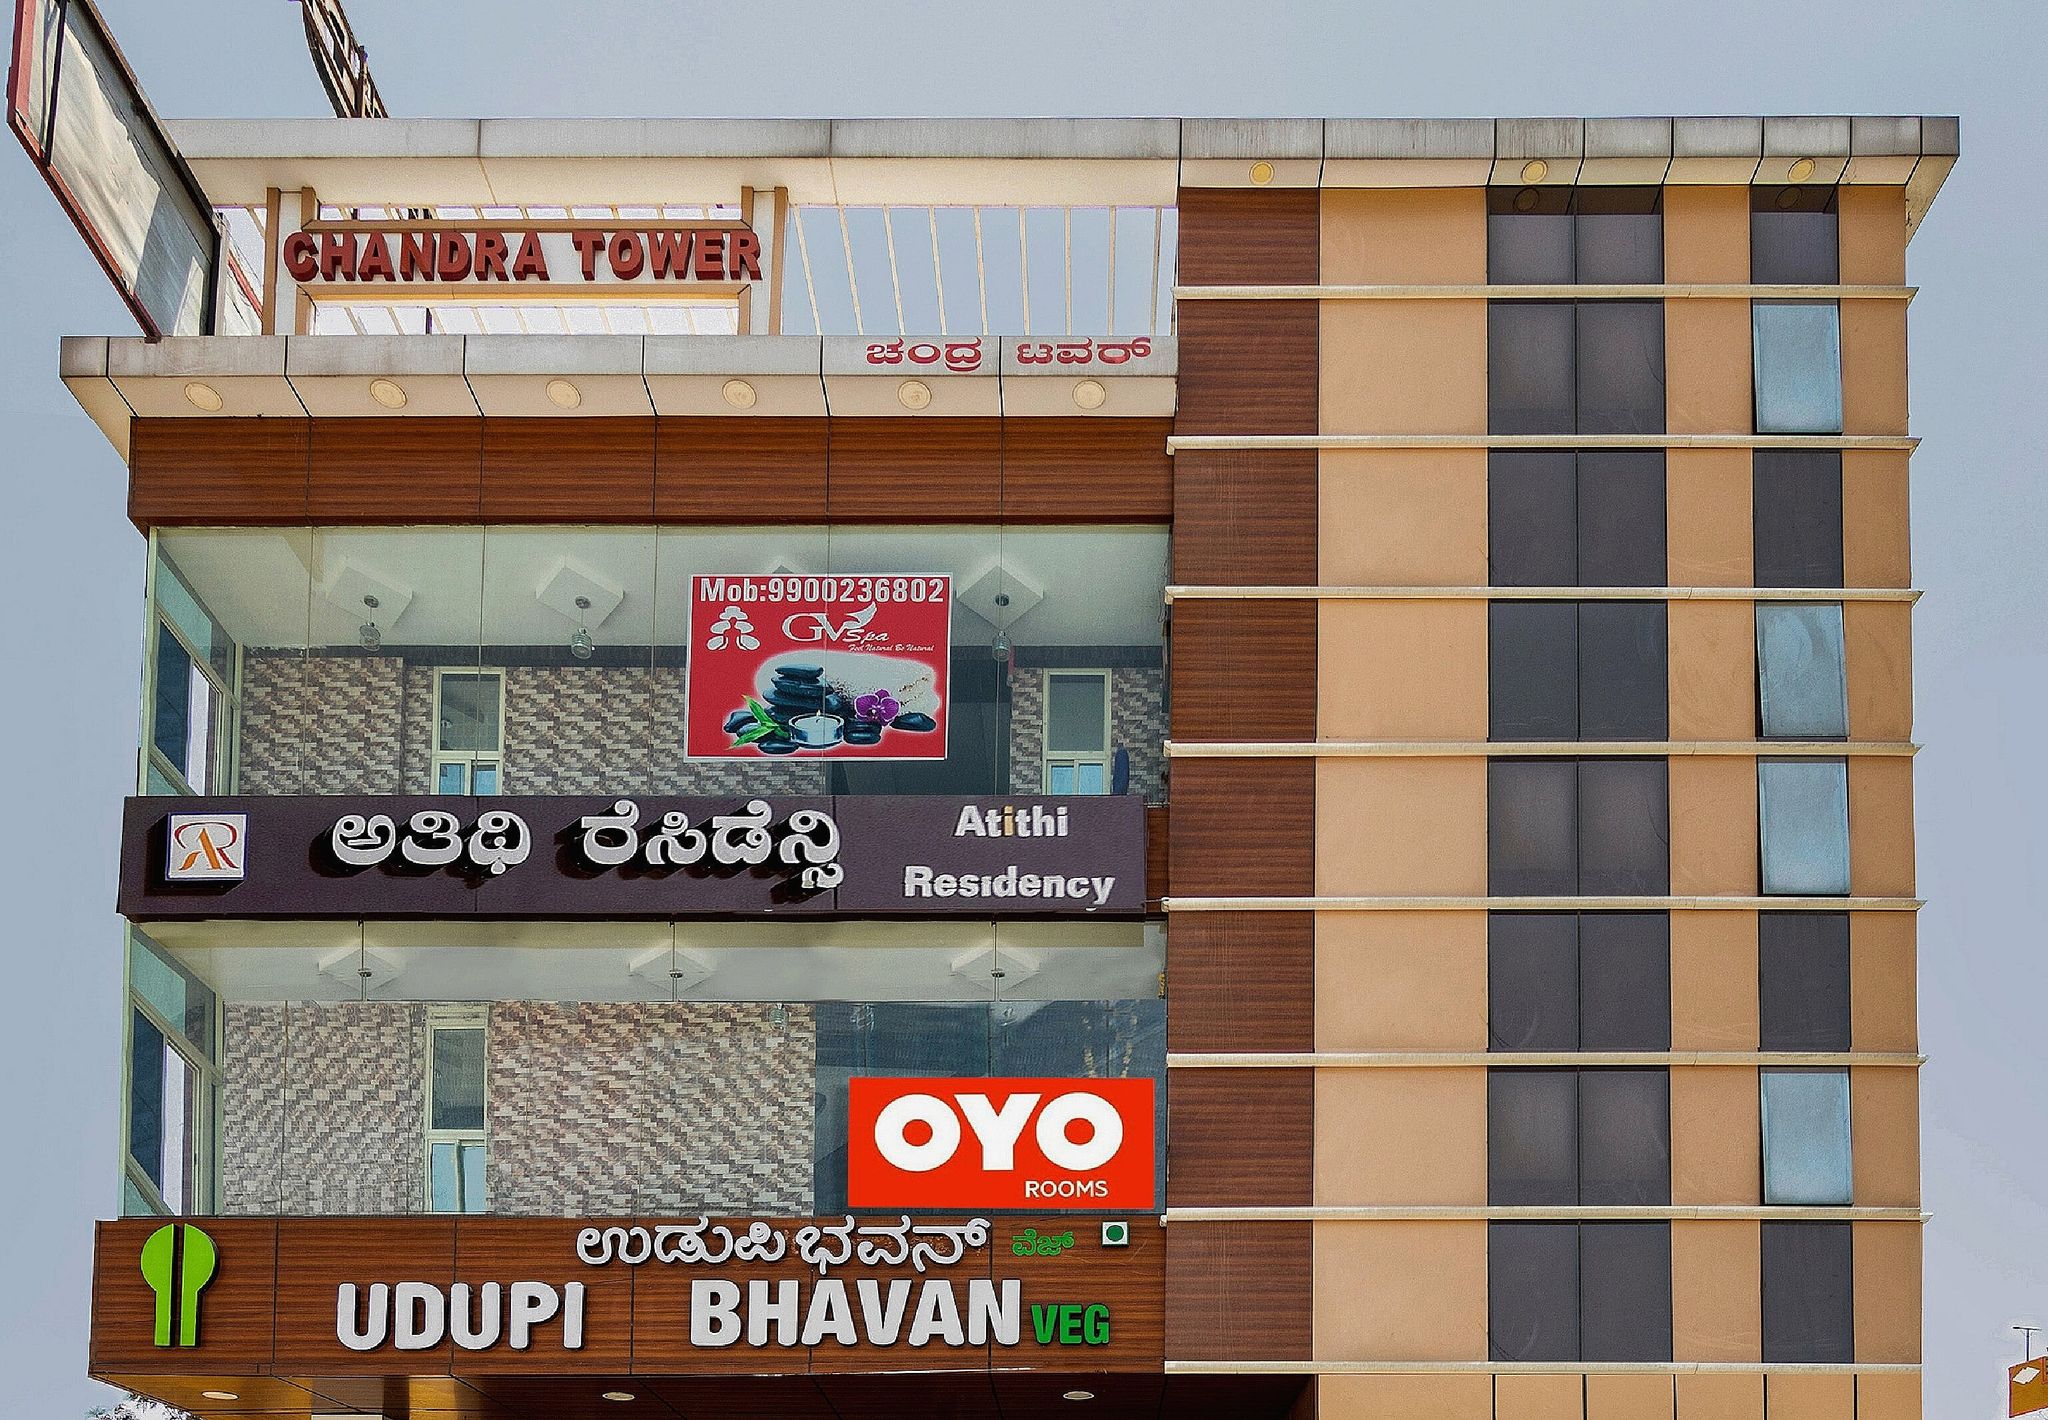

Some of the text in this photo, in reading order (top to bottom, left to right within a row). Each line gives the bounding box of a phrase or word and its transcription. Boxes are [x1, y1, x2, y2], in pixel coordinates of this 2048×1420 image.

[284, 228, 762, 282] CHANDRA TOWER
[866, 337, 1152, 372] ಚಂದ್ರ ಟವರ್
[700, 578, 944, 603] Mob:9900236802
[842, 628, 889, 644] Spa
[848, 643, 864, 652] Feel
[864, 643, 893, 652] Natural
[905, 643, 935, 652] Natural
[954, 805, 1068, 837] Atithi
[331, 799, 844, 889] ಅತಿಥಿ ರೆಸಿಡೆನ್ಸಿ
[904, 865, 1115, 904] Residency
[874, 1092, 1123, 1172] OYO
[1025, 1181, 1108, 1198] ROOMS
[576, 1215, 1075, 1273] ಉಡುಪಿ ಭವನ್ ವೆಜ್
[337, 1279, 1109, 1350] UDUPI BHAVAN VEG
